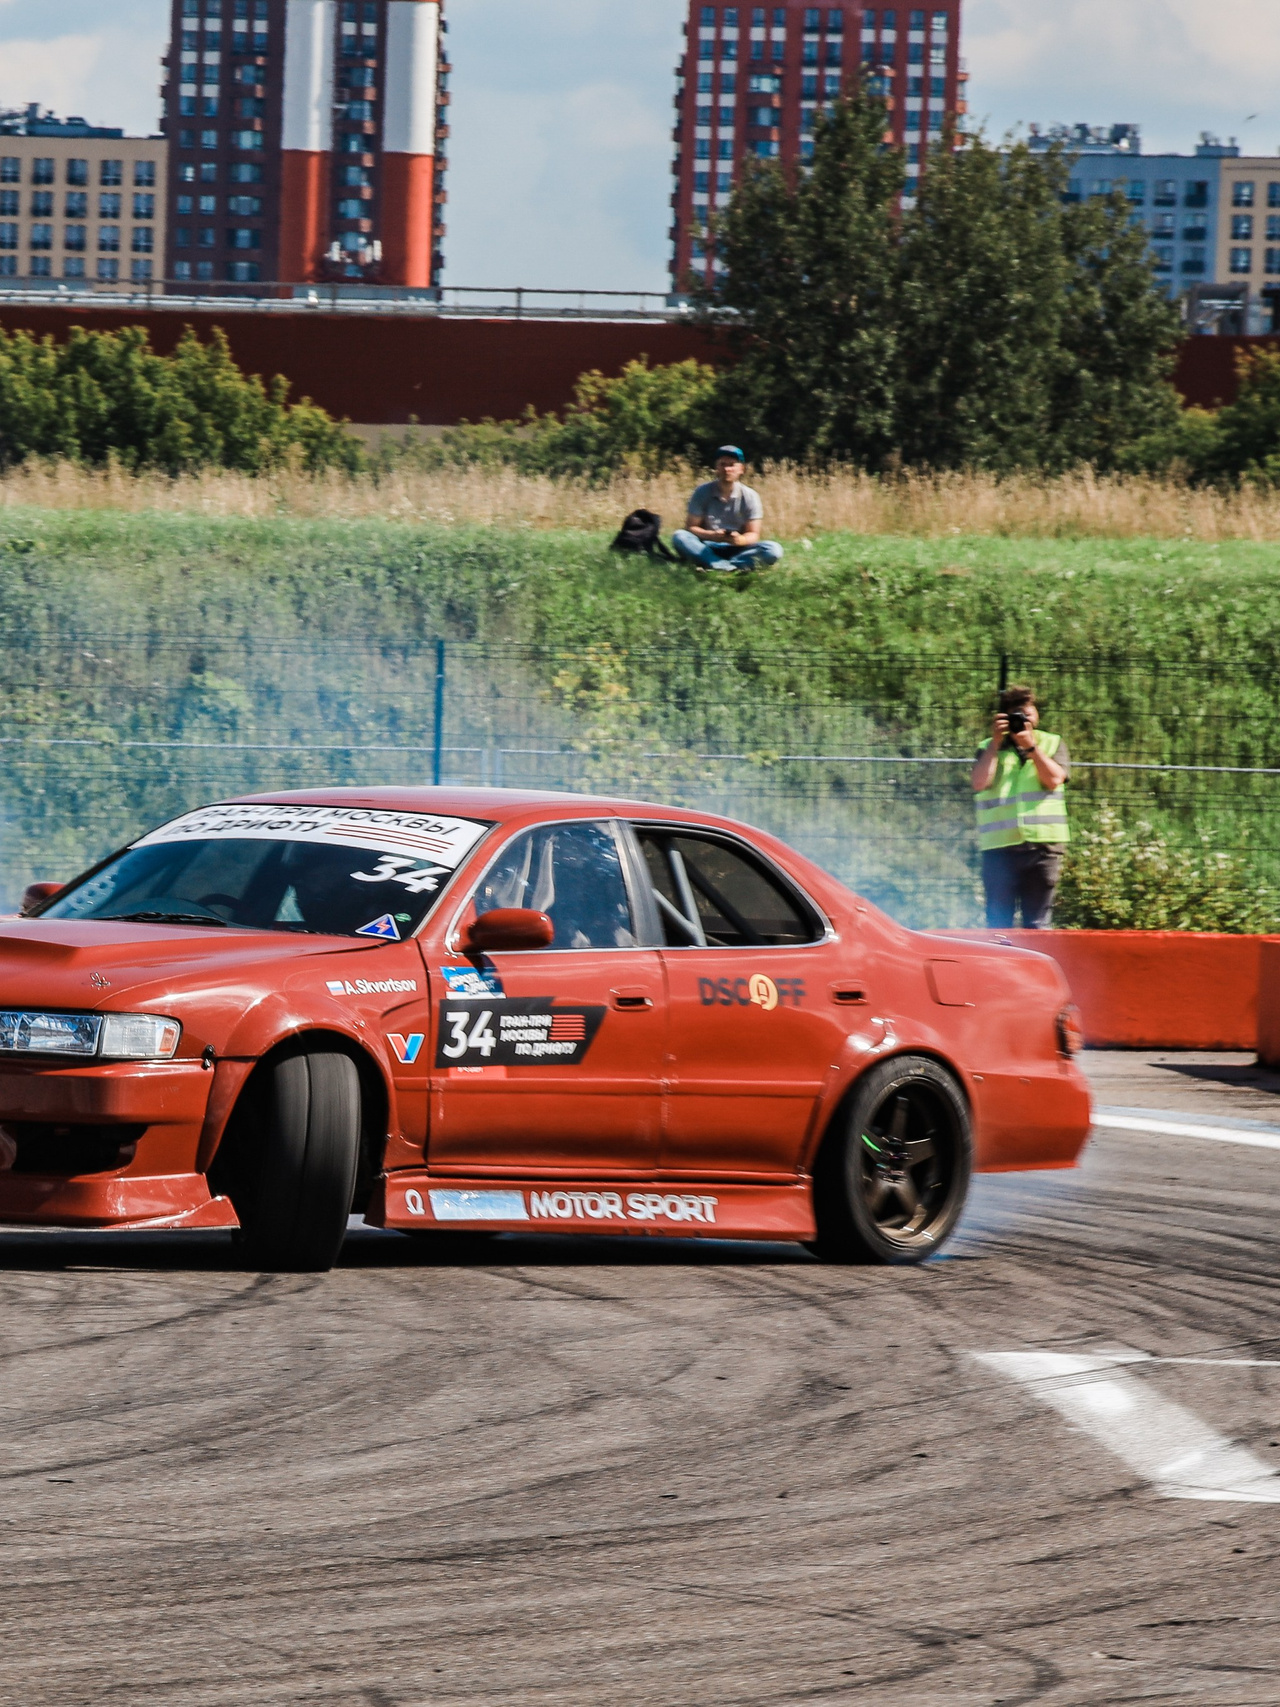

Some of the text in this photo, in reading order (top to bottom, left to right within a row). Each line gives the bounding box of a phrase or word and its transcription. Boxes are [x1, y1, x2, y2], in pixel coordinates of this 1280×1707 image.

[183, 807, 460, 836] ГРАН-ПРИ МОСКВЫ
[202, 819, 330, 833] ДРИФТУ
[349, 854, 453, 894] 34
[442, 1010, 497, 1058] 34
[530, 1190, 719, 1223] MOTOR SPORT
